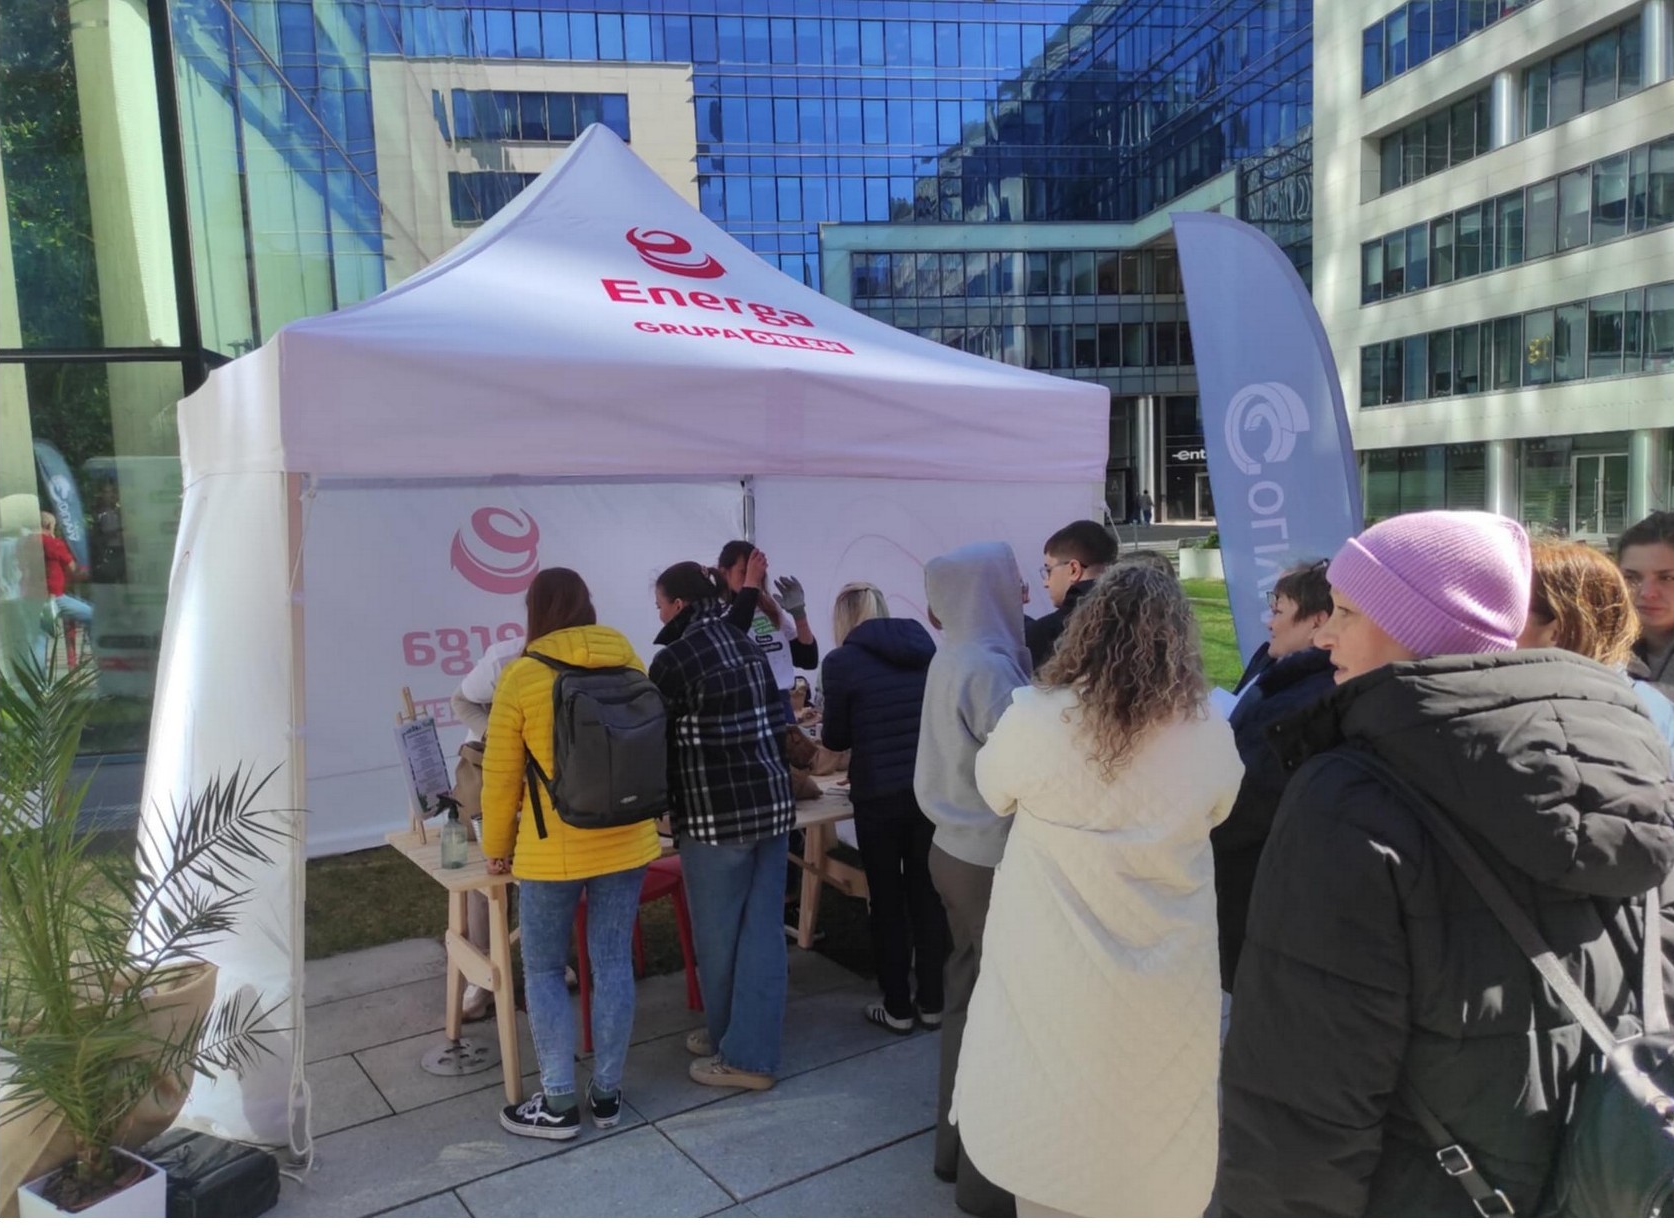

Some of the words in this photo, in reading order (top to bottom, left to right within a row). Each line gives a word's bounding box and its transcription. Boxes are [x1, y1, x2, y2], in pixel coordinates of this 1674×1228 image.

[601, 278, 815, 327] Energa
[634, 321, 745, 340] GRUPA
[744, 329, 850, 353] ORLEN
